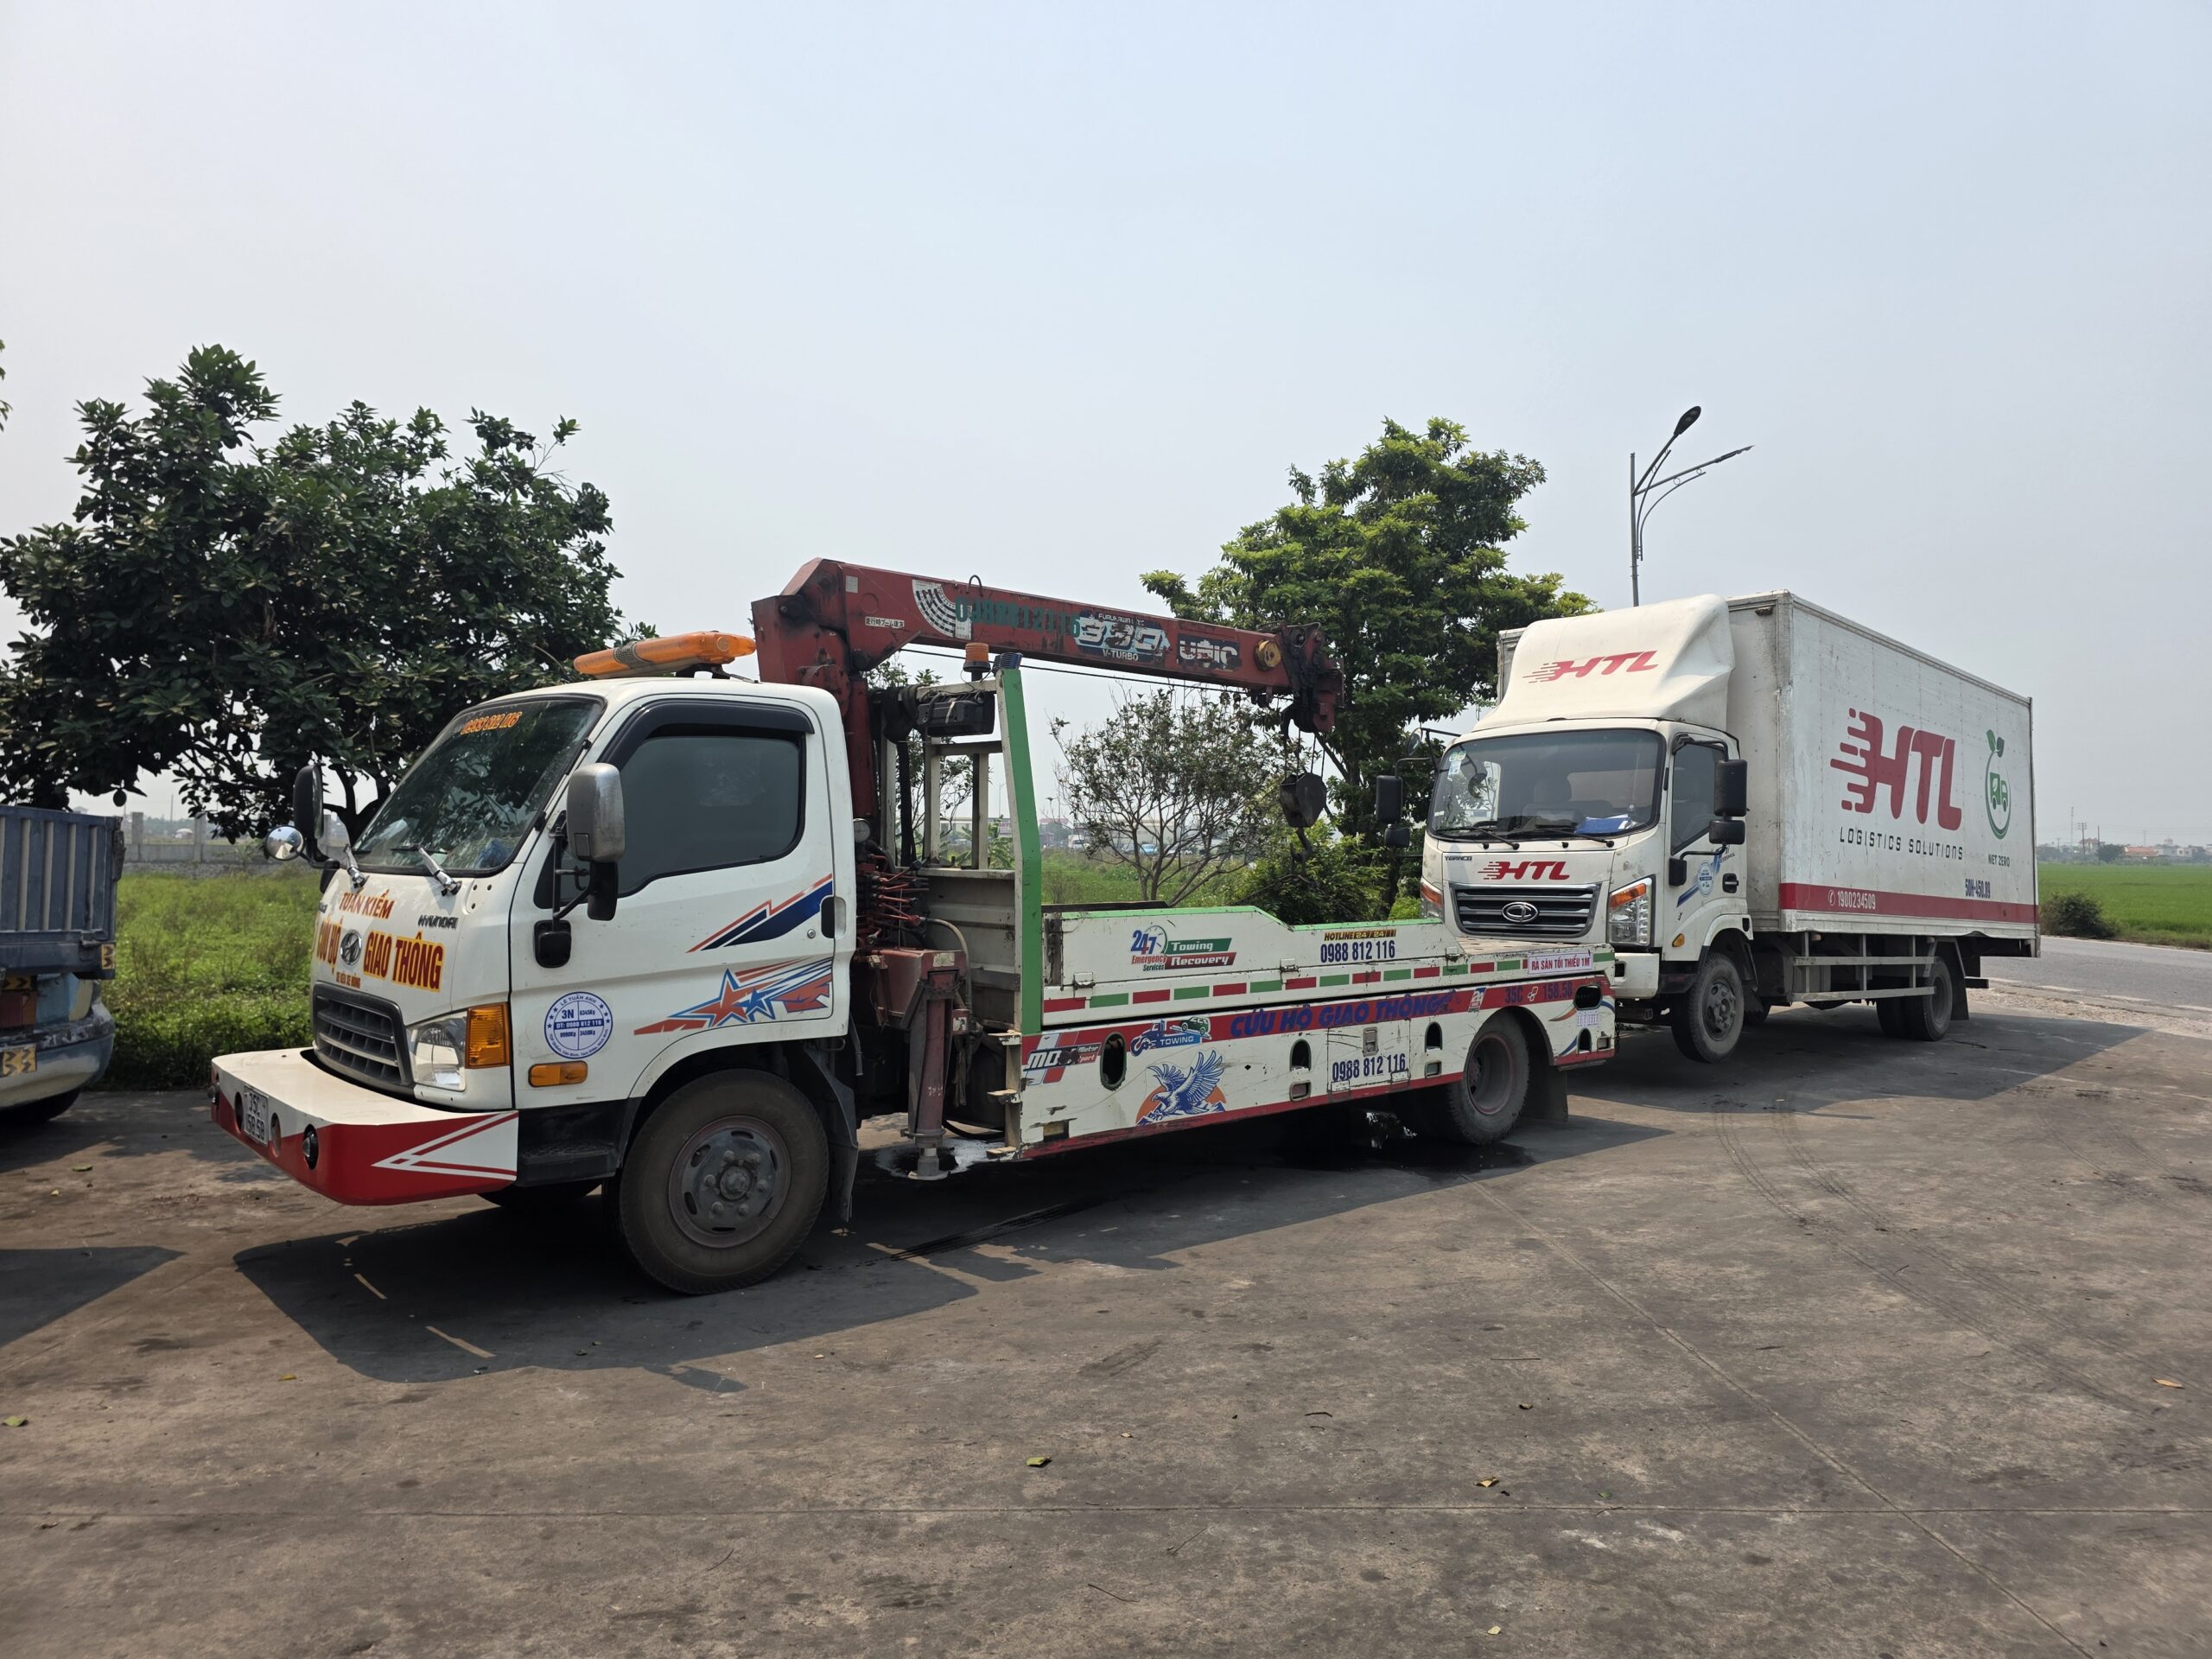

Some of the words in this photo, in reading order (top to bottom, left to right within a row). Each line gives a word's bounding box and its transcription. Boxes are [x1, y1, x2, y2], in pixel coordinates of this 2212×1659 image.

[1103, 650, 1139, 662] V-TURBO
[1534, 651, 1658, 682] HTL
[1839, 710, 1961, 831] HTL
[1840, 827, 1901, 851] LOGISTICS
[1998, 855, 2011, 867] ZERO
[1483, 861, 1570, 880] HTL
[417, 914, 459, 930] HYUNDAI
[1324, 931, 1354, 941] HOTLINE
[1171, 941, 1214, 952] Towing
[1320, 943, 1348, 963] 0988
[1352, 941, 1372, 961] 812
[1376, 939, 1395, 959] 116
[363, 931, 392, 979] GIAO
[391, 929, 444, 990] THÔNG
[1132, 954, 1167, 964] Emergency
[1171, 956, 1230, 966] Recovery
[1143, 963, 1165, 972] Services
[1505, 986, 1523, 1004] 35C
[562, 1009, 575, 1019] 3N
[1230, 1008, 1274, 1037] CỨU
[1280, 1003, 1313, 1033] HỘ
[1319, 1003, 1370, 1027] GIAO
[1375, 994, 1440, 1020] THÔNG
[1160, 1037, 1194, 1046] TOWING
[1332, 1058, 1359, 1081] 0988
[1363, 1056, 1383, 1077] 812
[1387, 1052, 1406, 1073] 116
